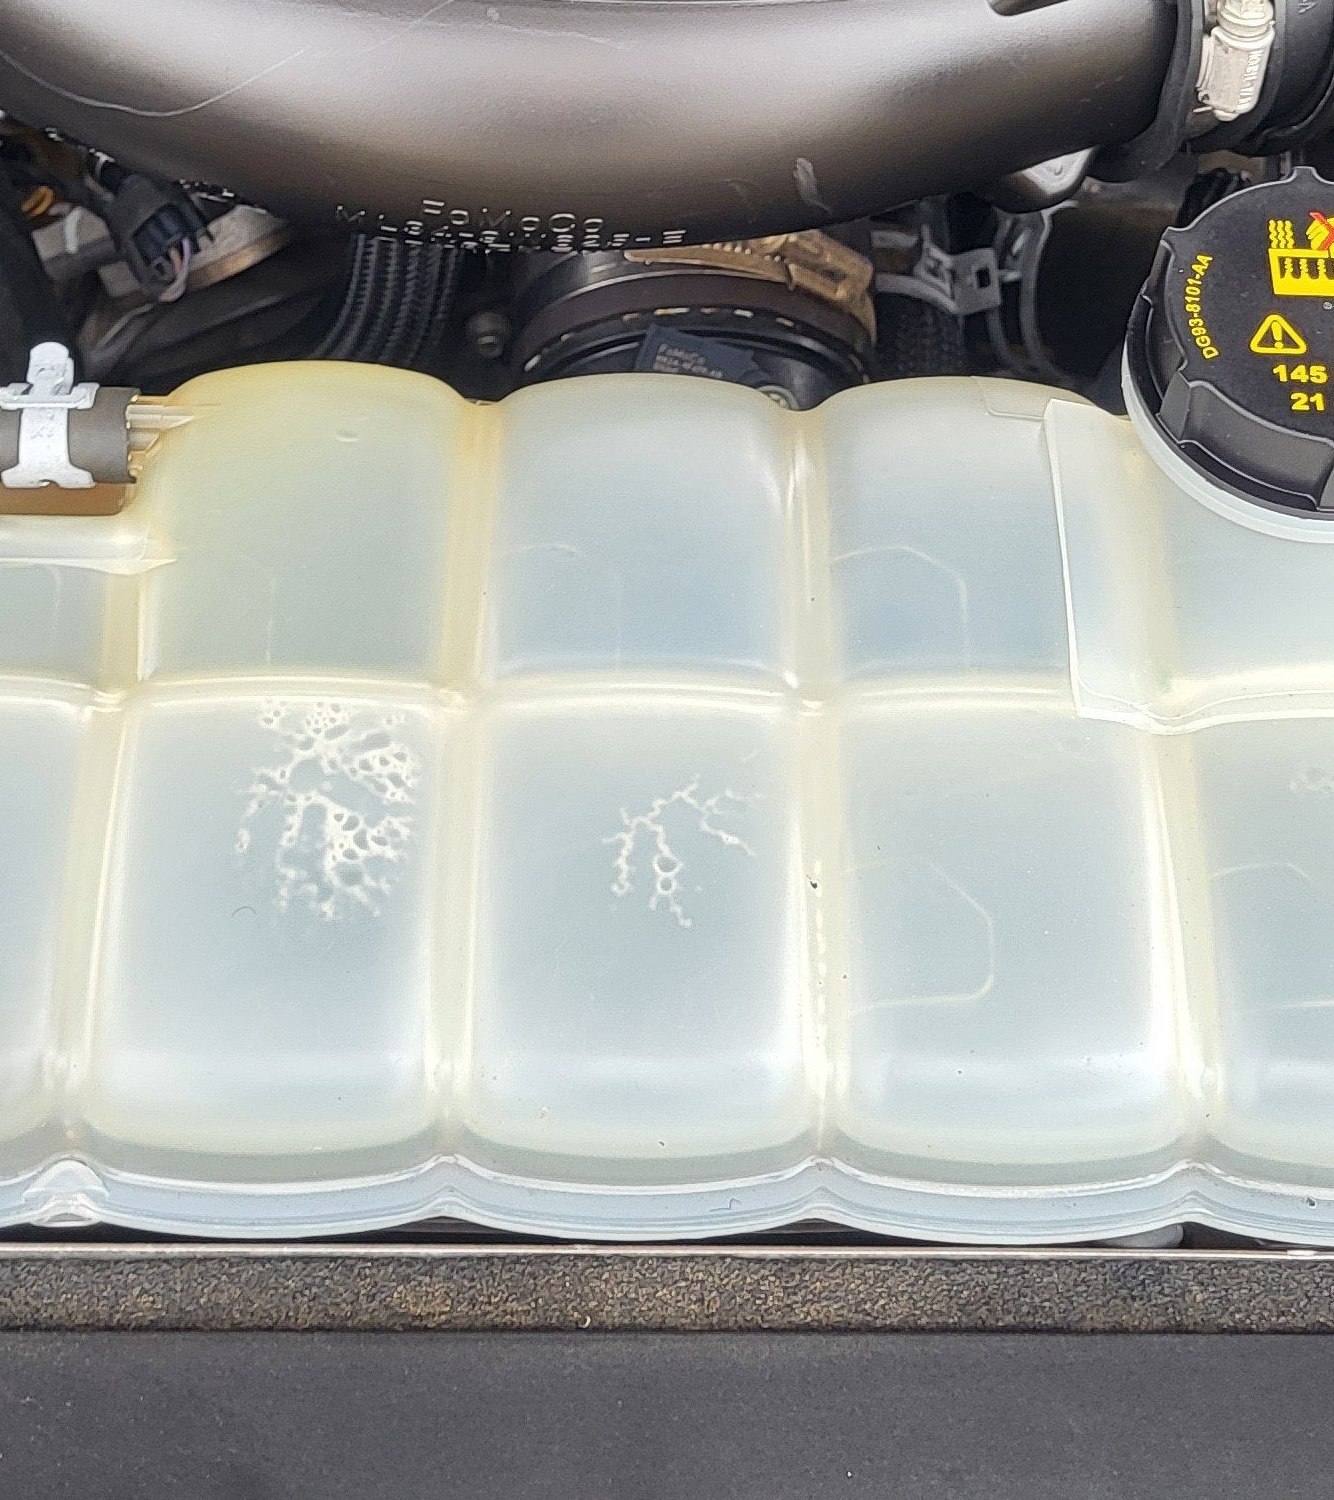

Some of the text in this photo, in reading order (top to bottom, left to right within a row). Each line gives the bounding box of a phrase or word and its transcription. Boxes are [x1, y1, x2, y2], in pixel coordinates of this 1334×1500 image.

[1184, 253, 1219, 360] DG93-8101-AA
[1272, 364, 1328, 385] 145
[1289, 392, 1326, 412] 21
